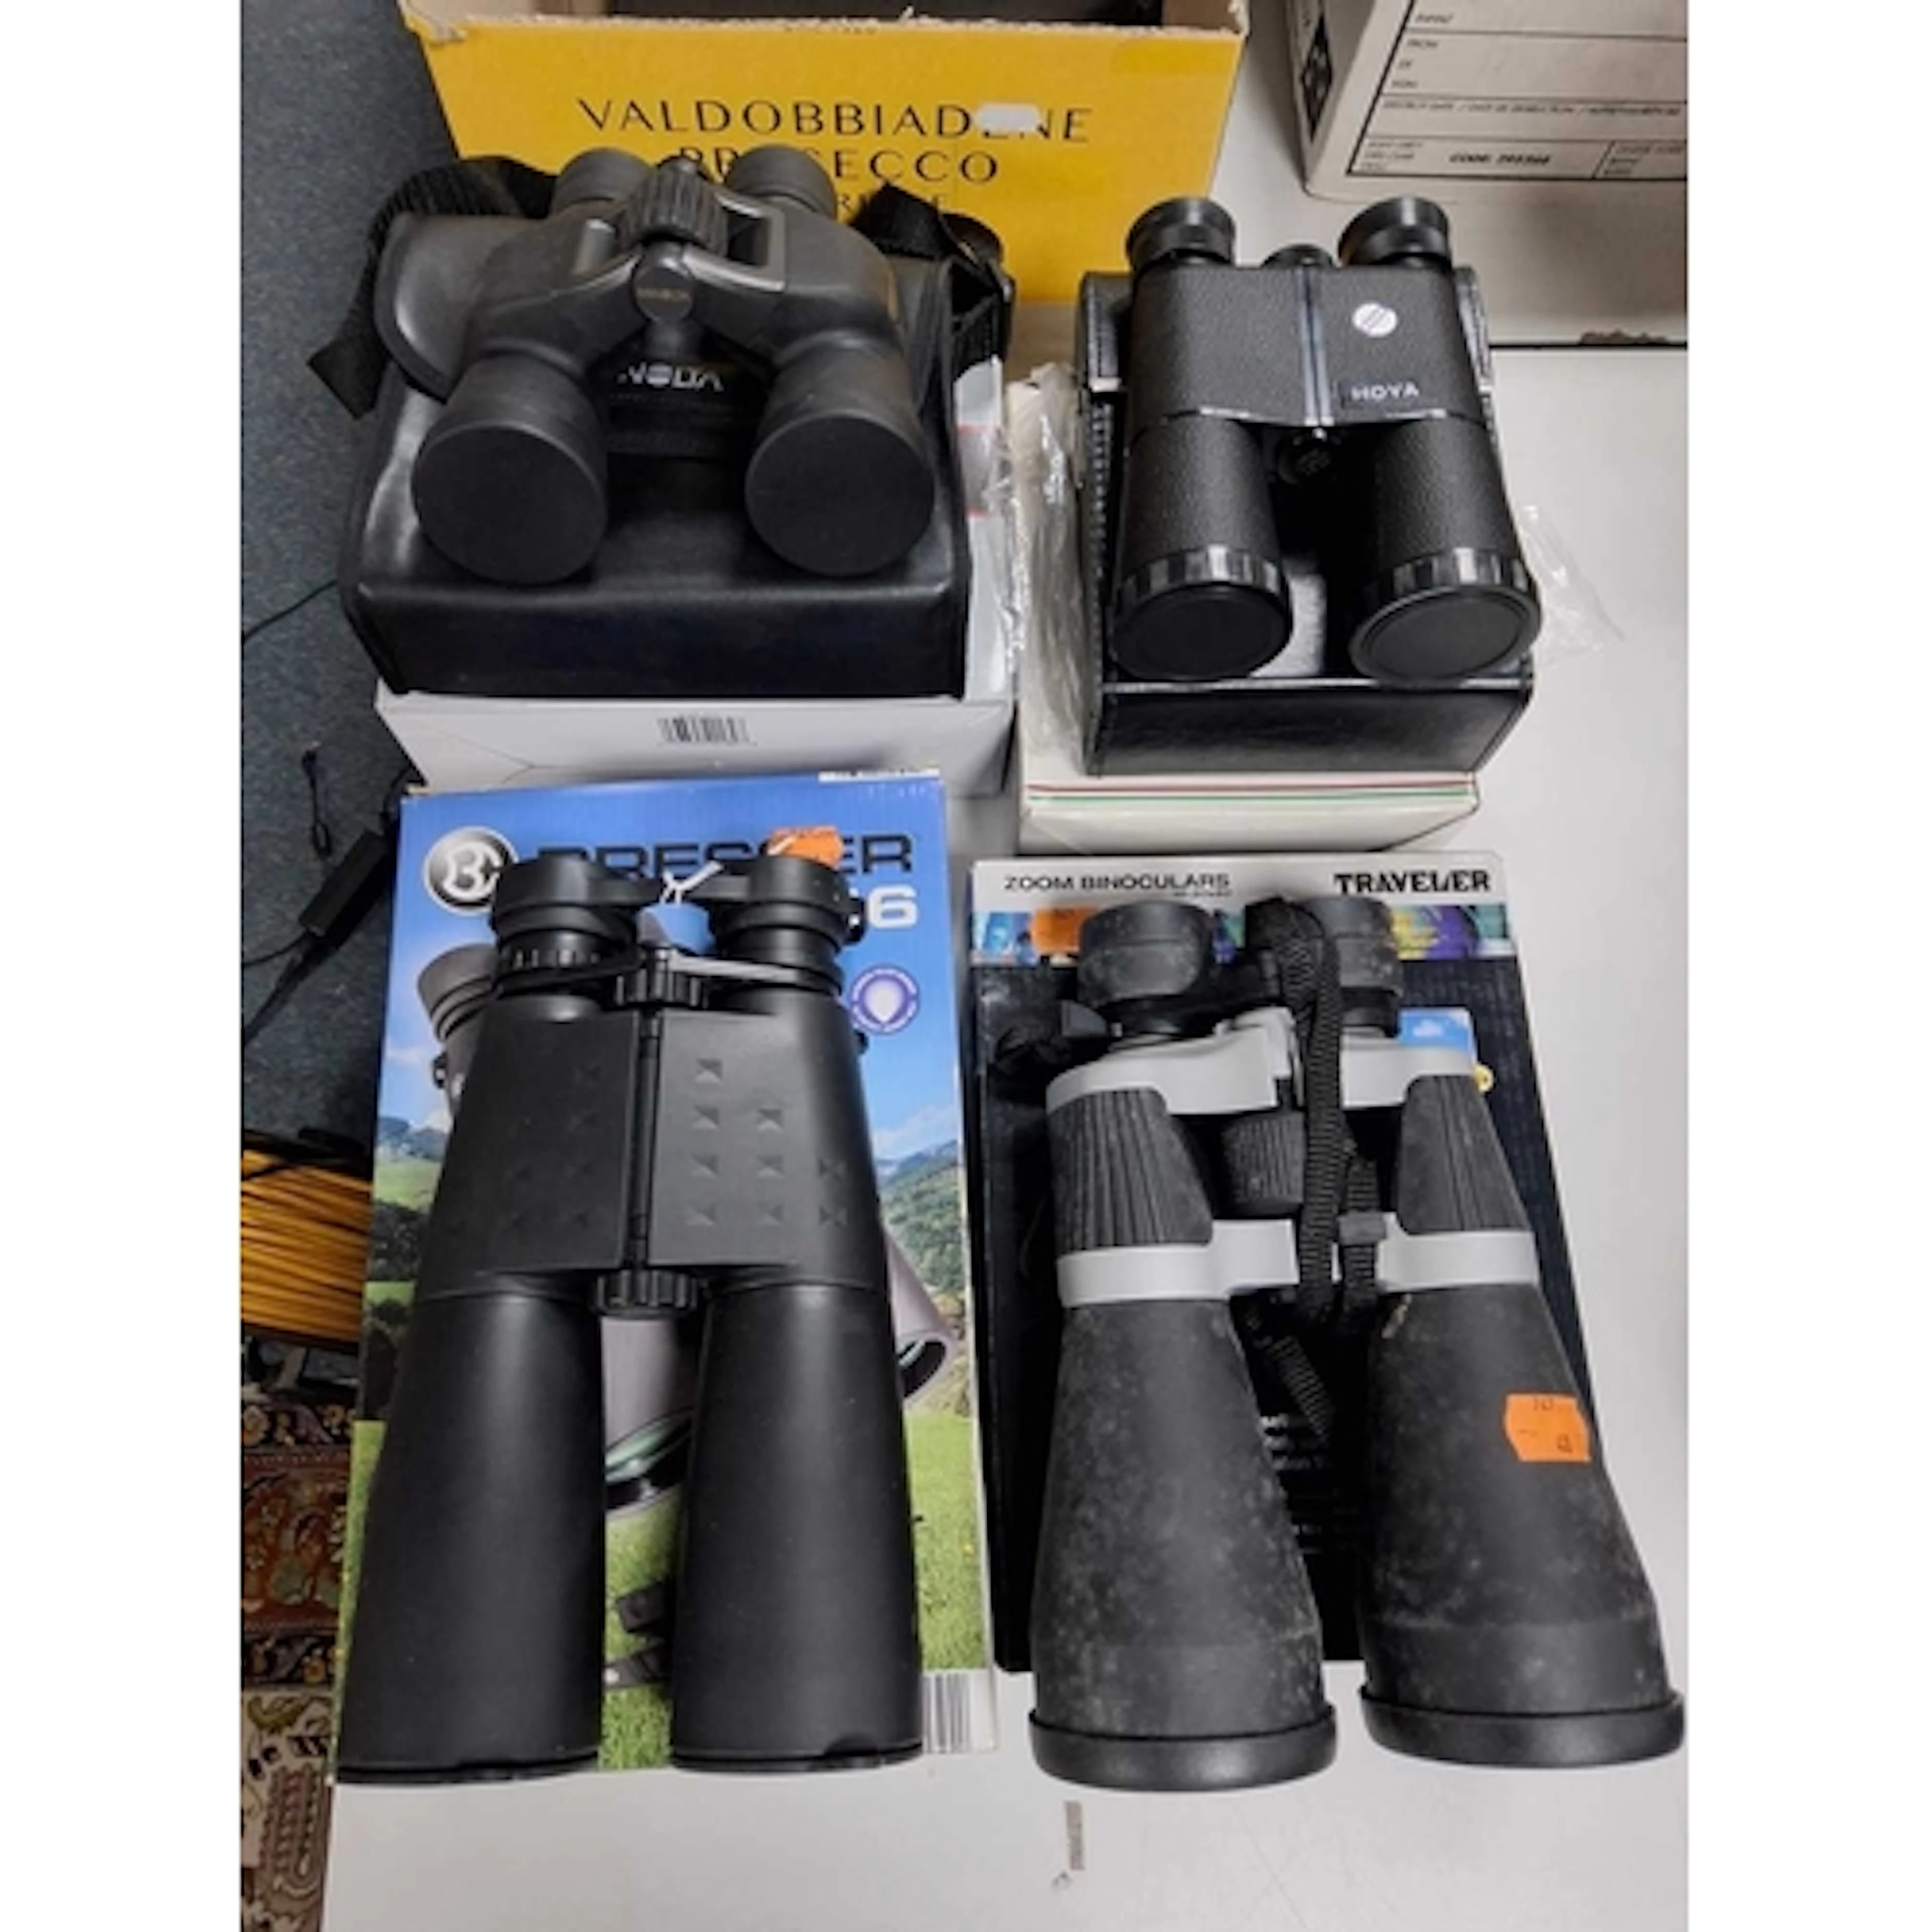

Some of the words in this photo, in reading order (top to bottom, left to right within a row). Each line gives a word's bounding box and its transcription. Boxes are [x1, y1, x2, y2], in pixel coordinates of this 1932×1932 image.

[578, 99, 1093, 141] VALDOBBIADNE
[1351, 381, 1420, 401] HOYA
[1004, 875, 1074, 890] ZOOM
[1082, 873, 1230, 890] BINOCULARS
[1334, 869, 1492, 894] TRAVELER
